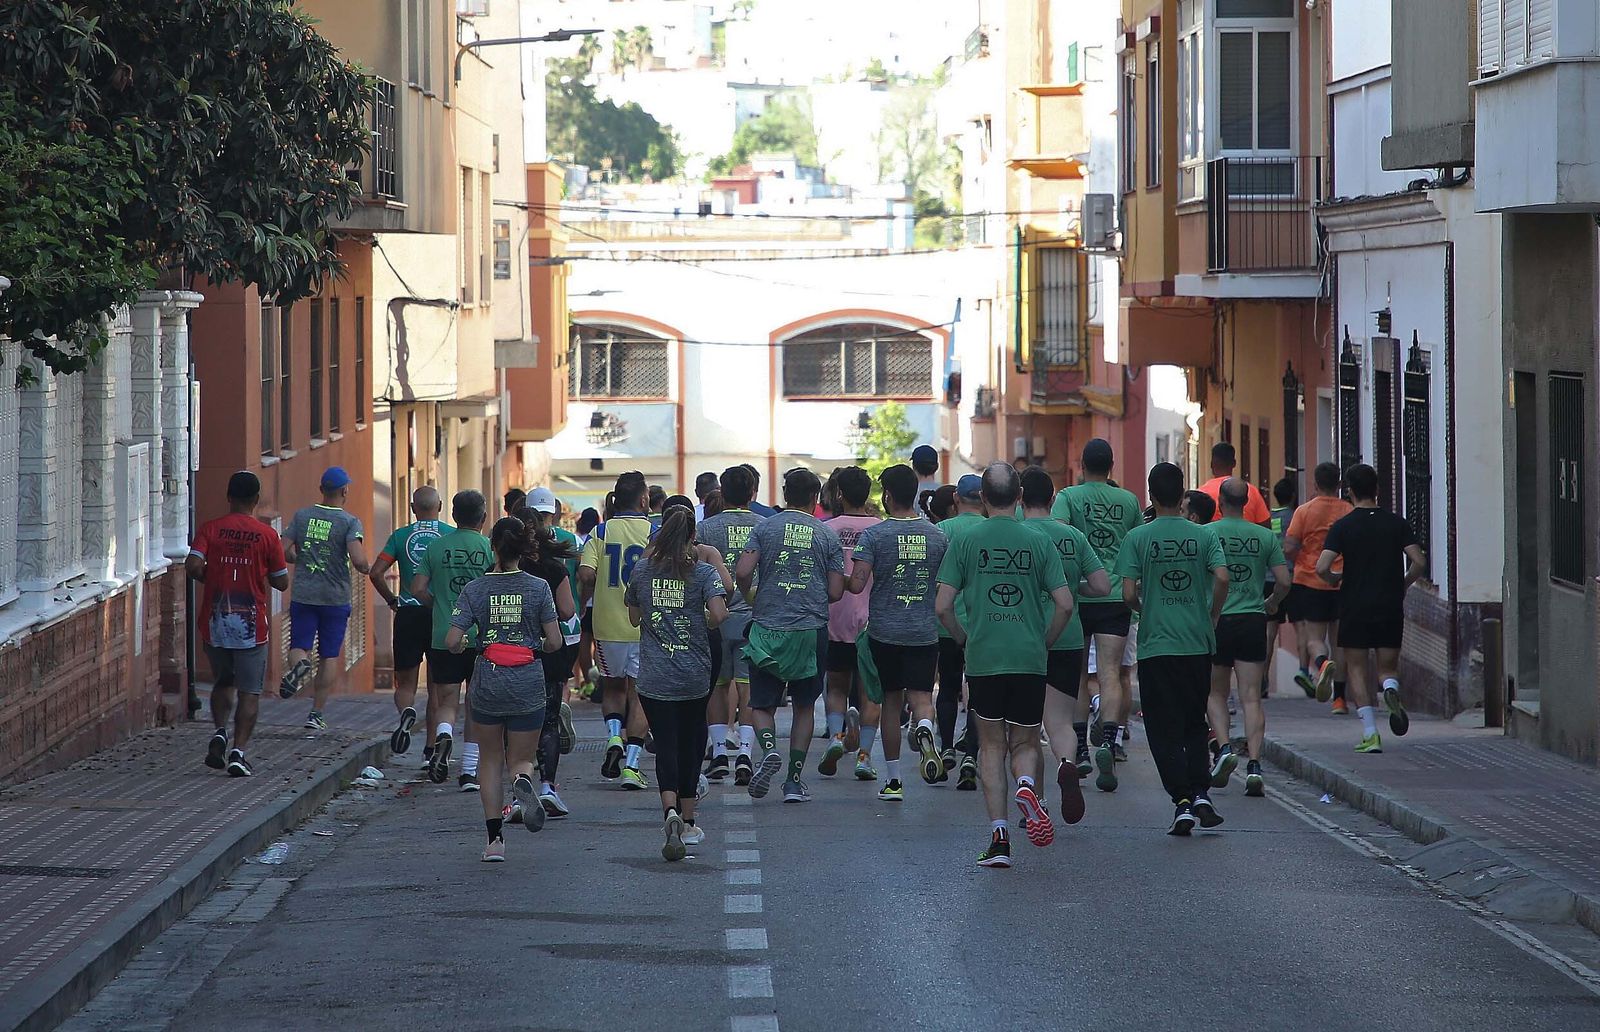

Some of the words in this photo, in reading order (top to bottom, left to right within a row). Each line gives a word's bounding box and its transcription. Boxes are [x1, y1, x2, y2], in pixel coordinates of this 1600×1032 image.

[728, 526, 736, 534] EL
[785, 523, 793, 531] EL
[794, 524, 813, 534] PEOR
[219, 528, 262, 543] PIRATAS
[898, 535, 907, 544] EL
[907, 535, 926, 544] PEOR
[1052, 539, 1075, 555] XO
[1164, 539, 1198, 557] EXO
[1229, 537, 1260, 553] EXO
[454, 549, 486, 566] EXO
[993, 549, 1031, 570] EXO
[652, 578, 662, 589] EL
[662, 579, 685, 590] PEOR
[489, 595, 500, 606] EL
[500, 594, 523, 605] PEOR
[652, 598, 662, 606] DEL
[662, 599, 684, 608] MUNDO
[1161, 597, 1195, 606] TOMAX
[489, 615, 500, 624] DEL
[500, 615, 522, 623] MUNDO
[988, 612, 1024, 623] TOMAX
